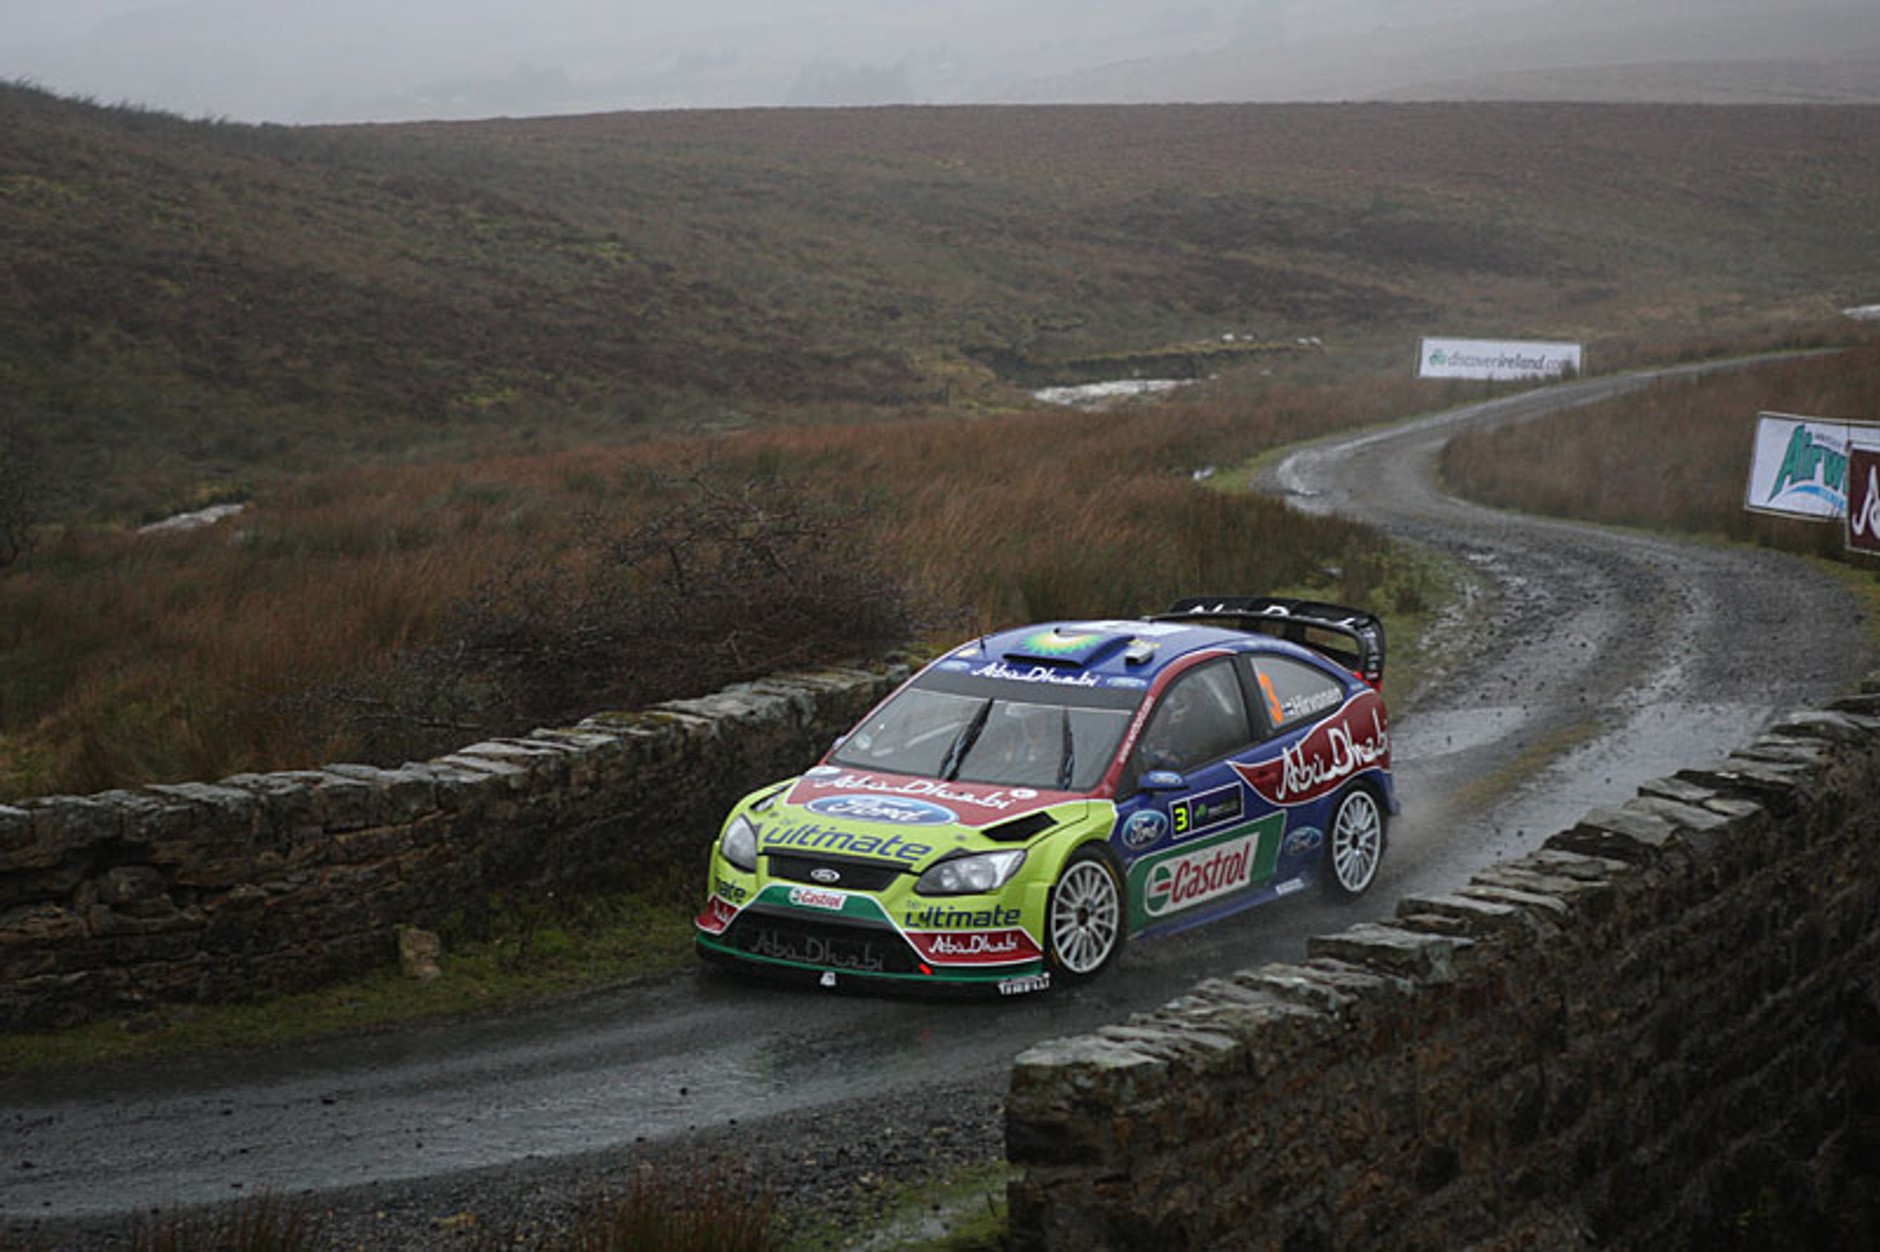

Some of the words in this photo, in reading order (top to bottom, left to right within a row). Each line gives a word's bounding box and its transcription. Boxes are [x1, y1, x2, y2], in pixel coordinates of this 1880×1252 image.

[1448, 352, 1566, 371] discoverireland.co
[1768, 424, 1848, 503] Airw
[1260, 672, 1283, 725] 3
[1175, 808, 1188, 831] 3
[763, 824, 932, 861] ultimate
[1171, 842, 1250, 903] Castrol
[801, 890, 842, 908] Castrol
[905, 904, 1021, 927] ultimate
